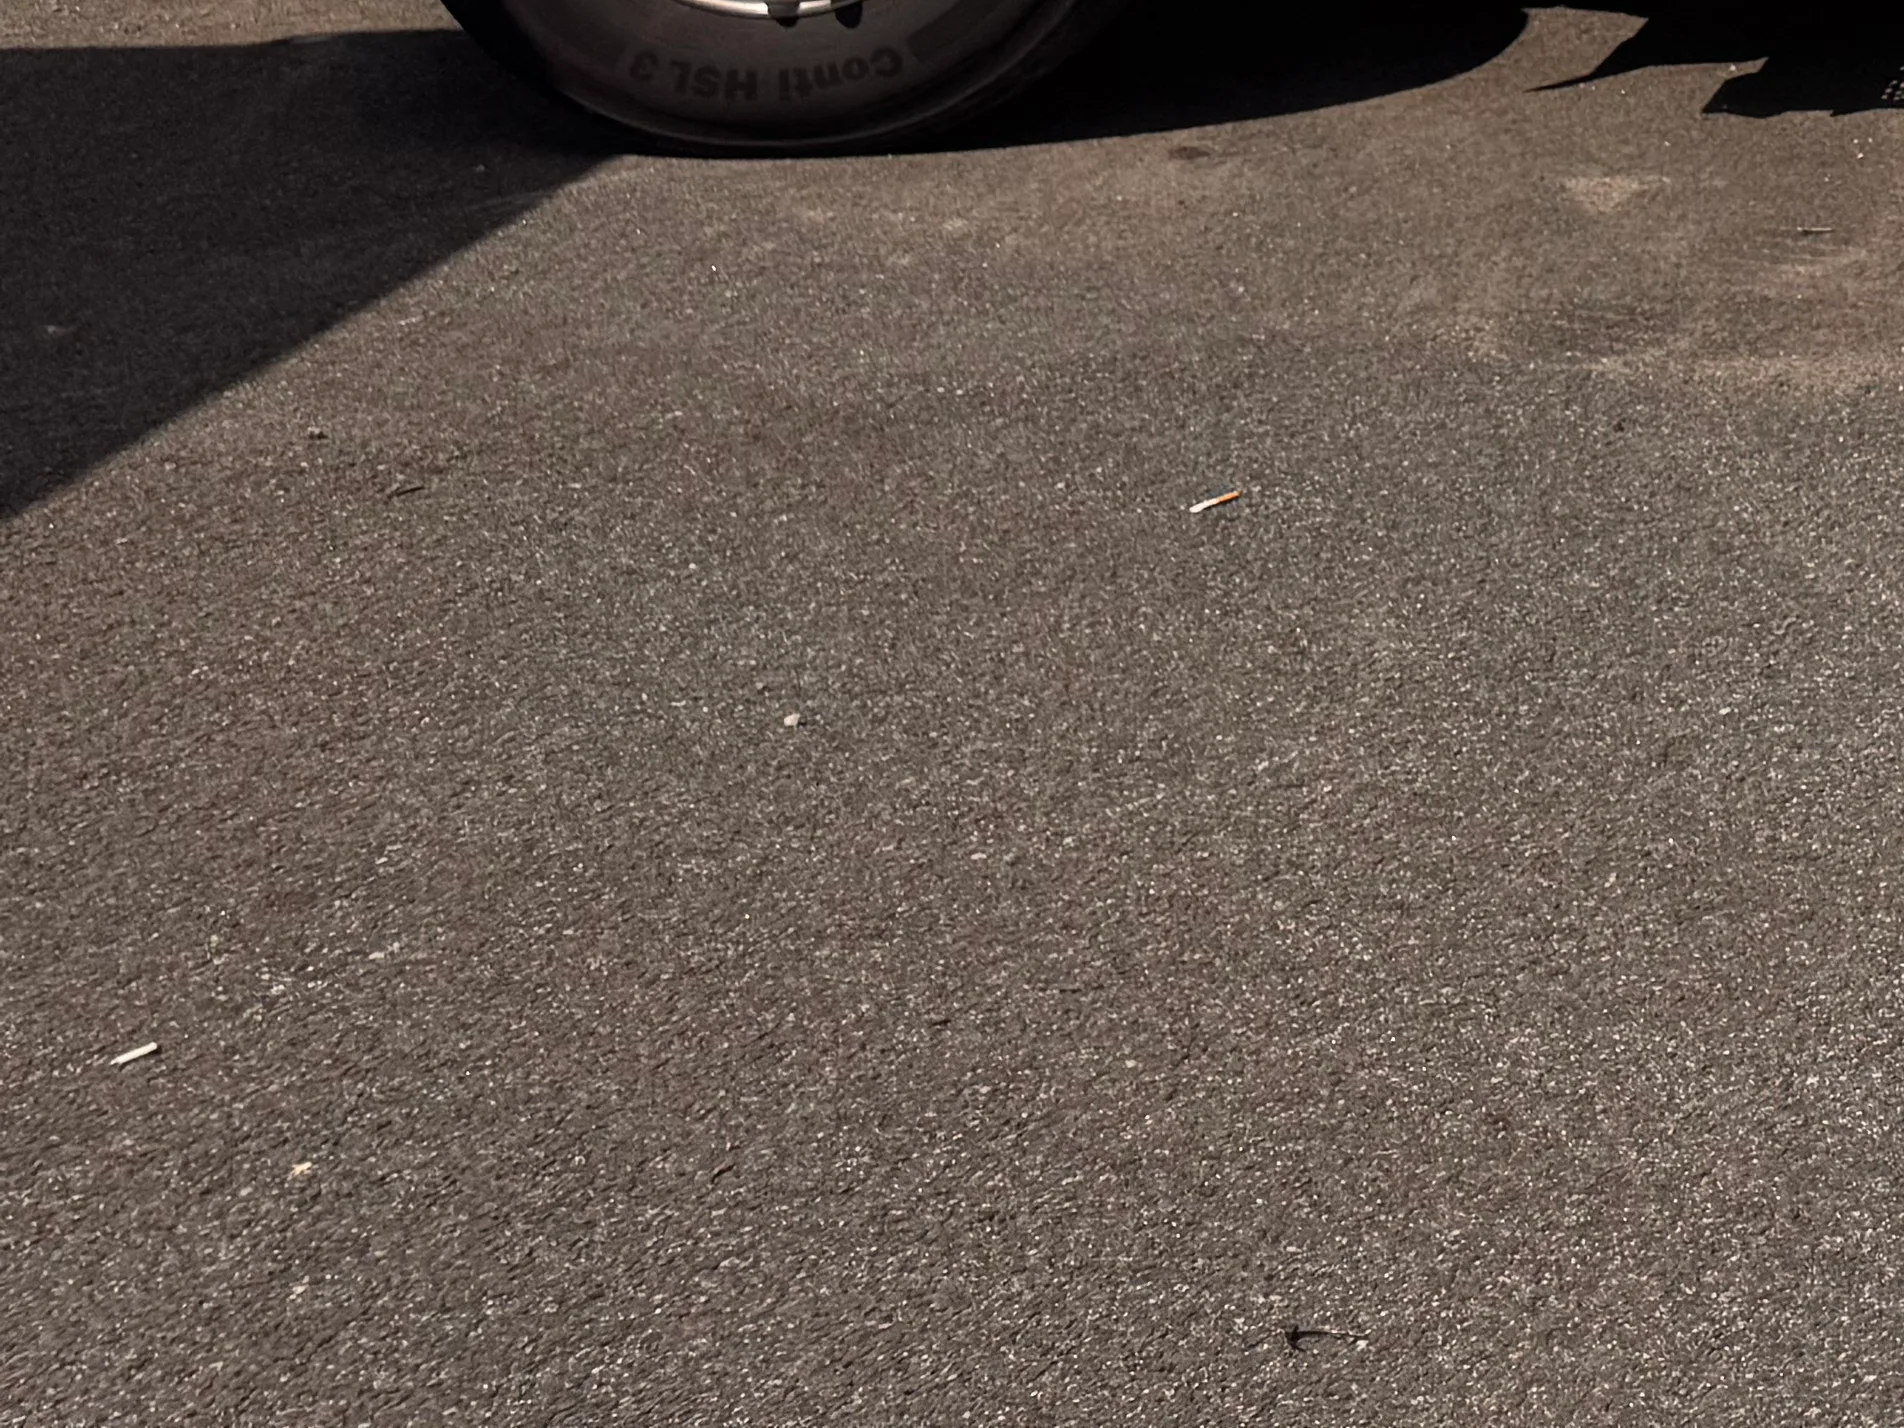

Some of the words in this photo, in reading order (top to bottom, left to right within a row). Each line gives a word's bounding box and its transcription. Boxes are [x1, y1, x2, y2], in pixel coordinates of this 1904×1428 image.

[626, 48, 660, 82] 3
[669, 57, 759, 103] HSL
[775, 46, 905, 104] Conti
